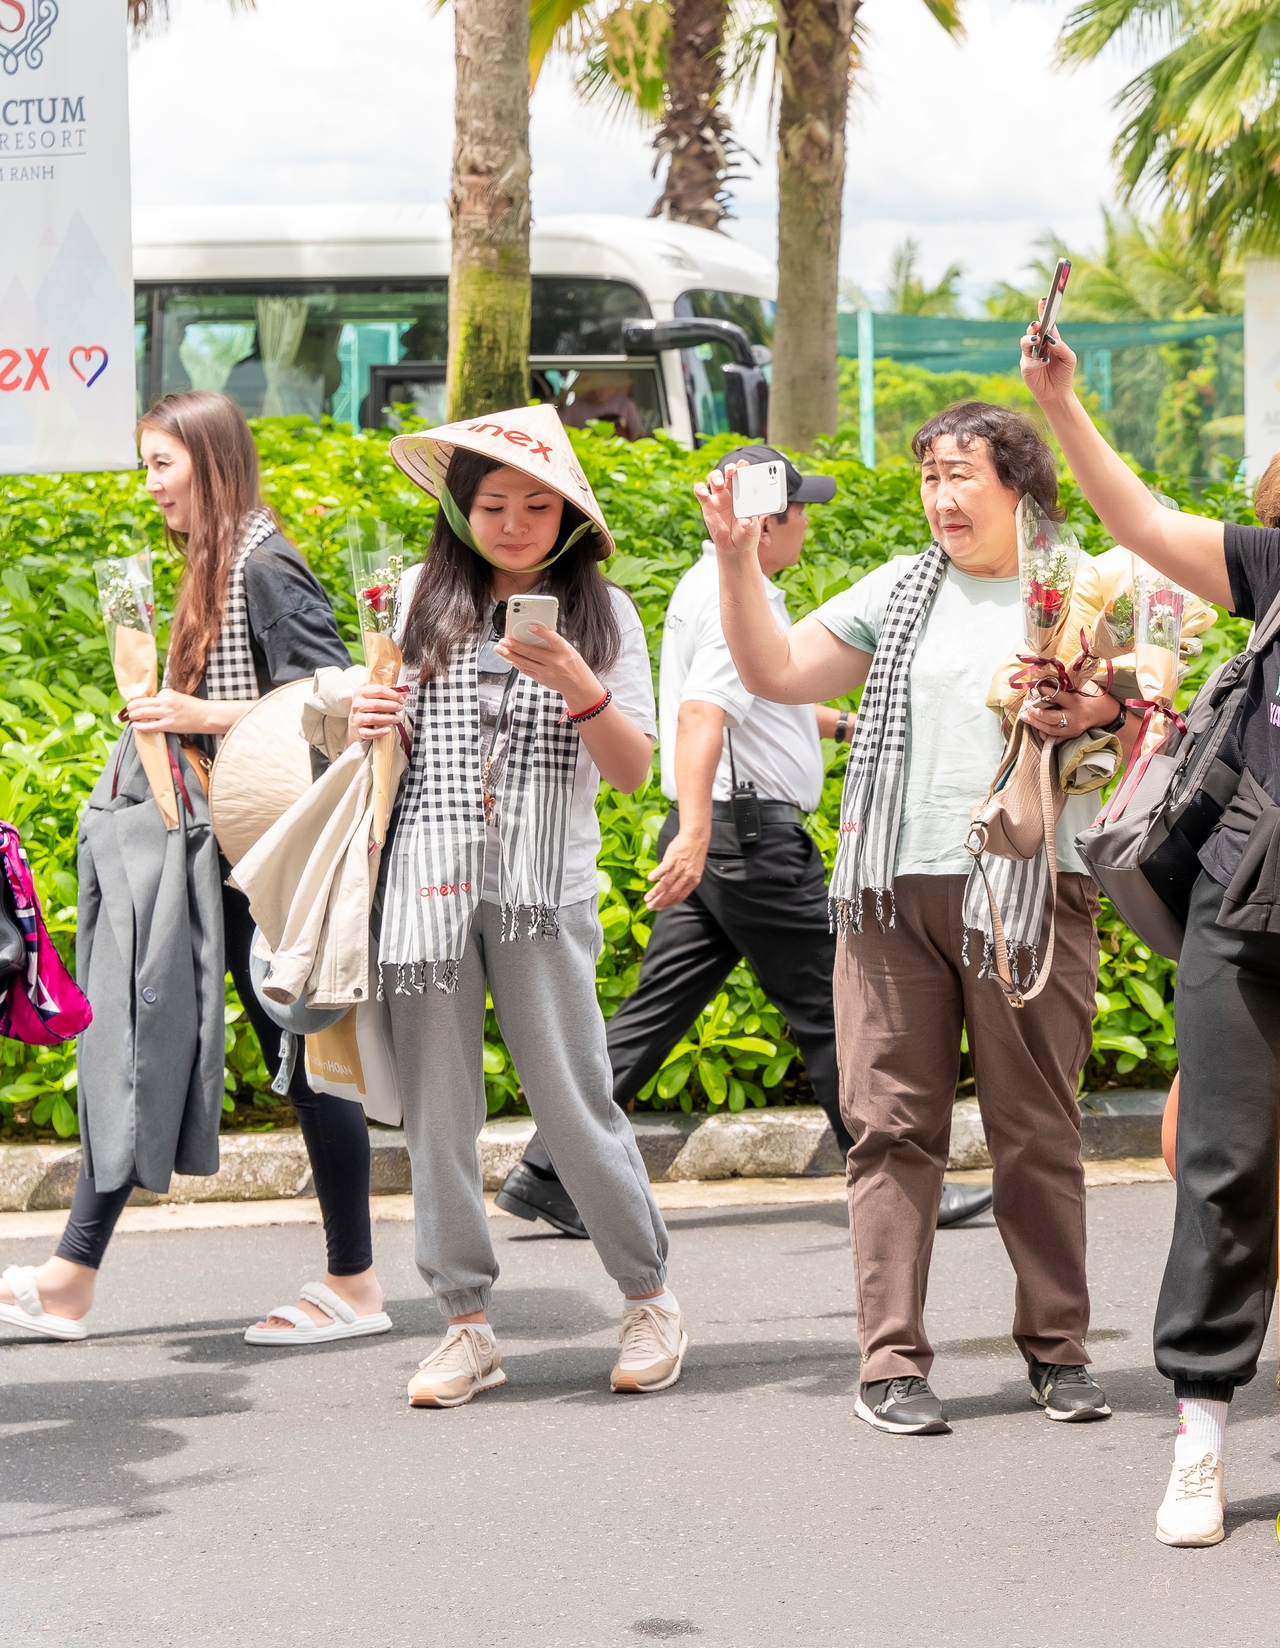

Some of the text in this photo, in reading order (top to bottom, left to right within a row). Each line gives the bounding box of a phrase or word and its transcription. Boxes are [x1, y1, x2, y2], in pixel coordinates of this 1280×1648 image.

[0, 96, 86, 126] CTUM
[10, 165, 55, 182] RANH
[0, 347, 50, 391] ex
[448, 422, 553, 463] anex
[419, 884, 457, 898] anex
